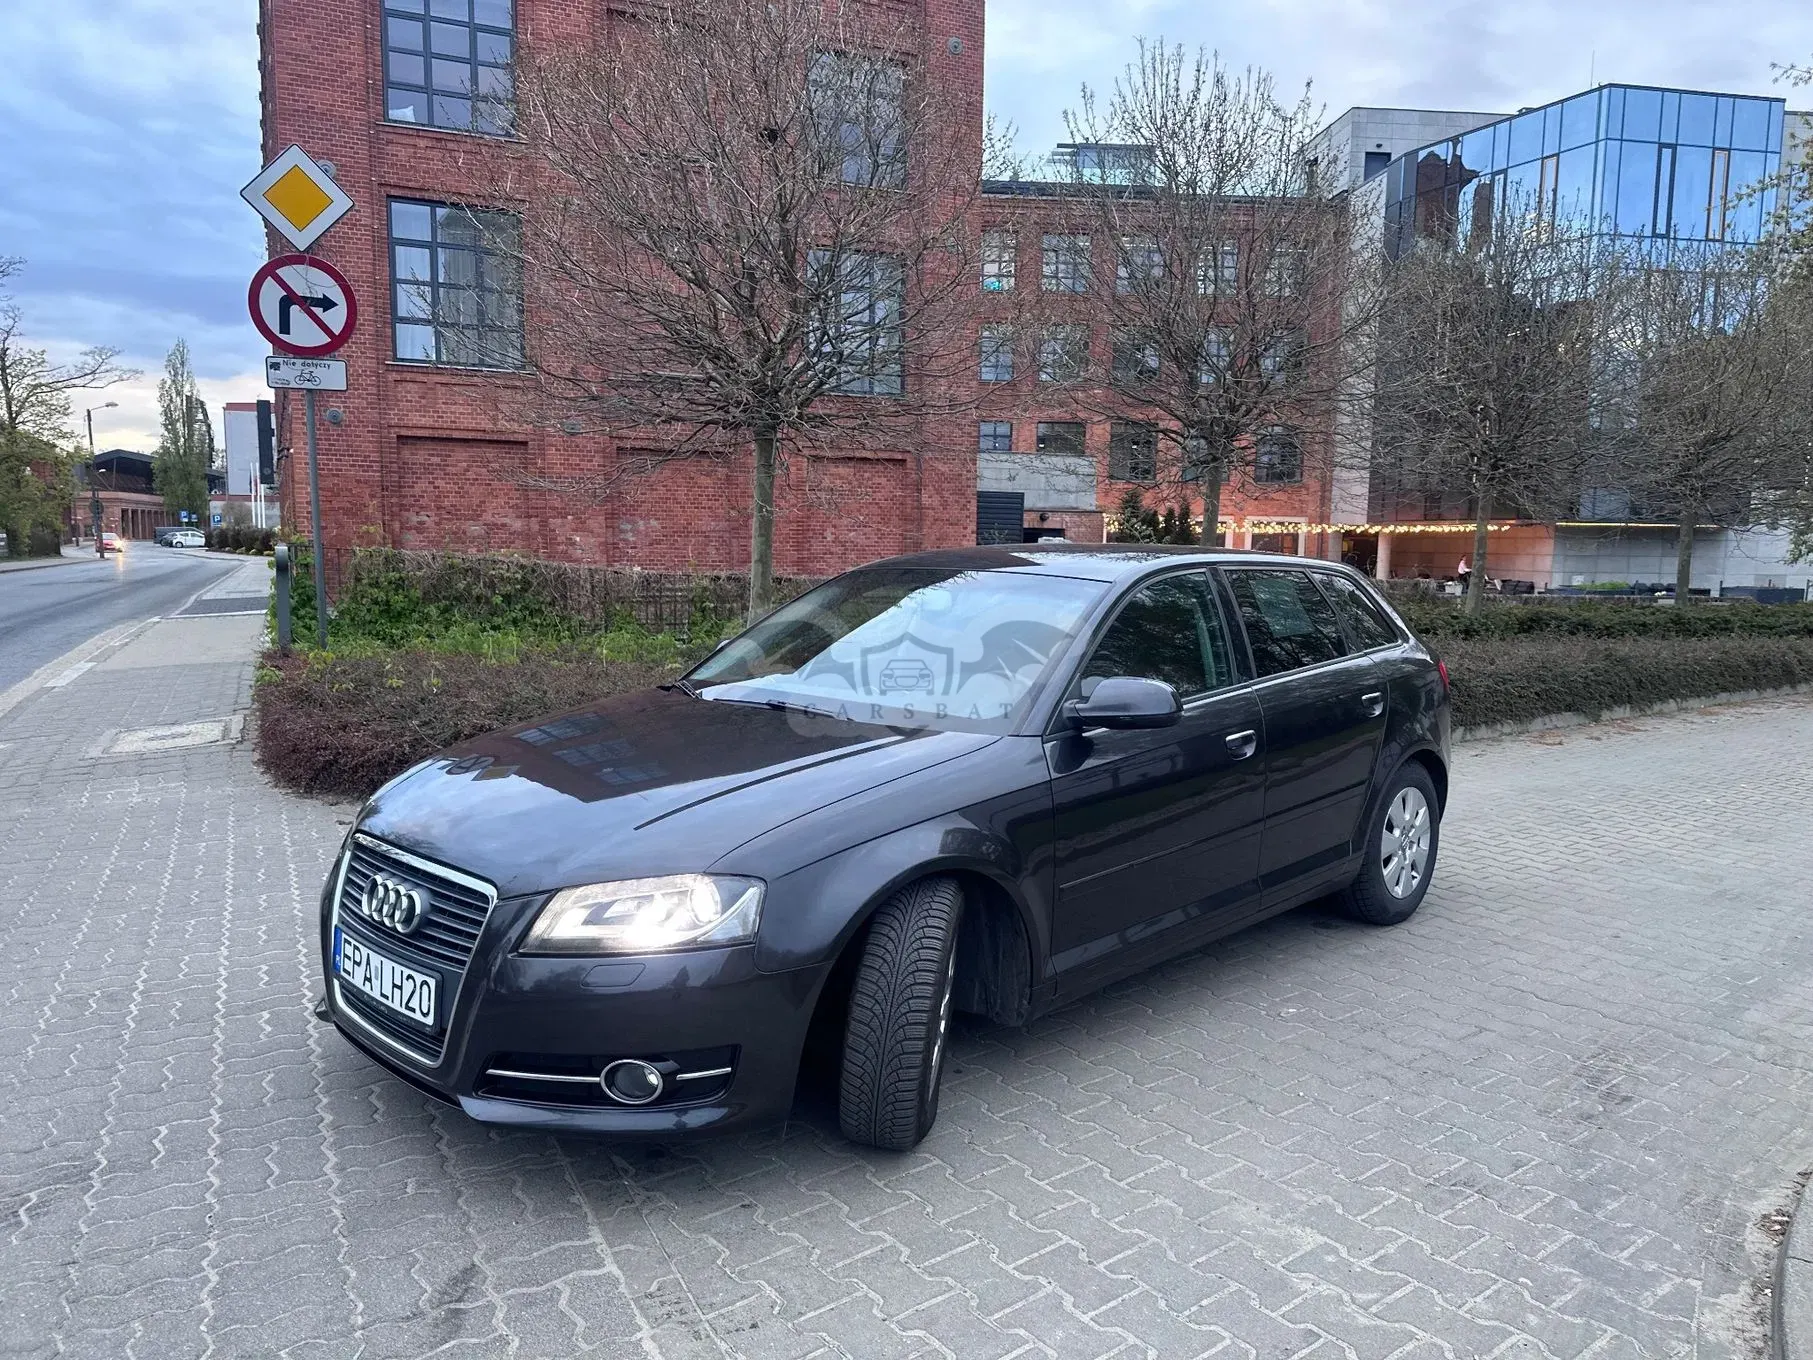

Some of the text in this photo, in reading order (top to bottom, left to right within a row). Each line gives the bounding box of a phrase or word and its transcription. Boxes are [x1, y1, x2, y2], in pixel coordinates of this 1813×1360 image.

[282, 359, 297, 367] Nie
[301, 360, 331, 370] dotyczy
[342, 936, 374, 992] EPA
[380, 959, 432, 1018] LH20
